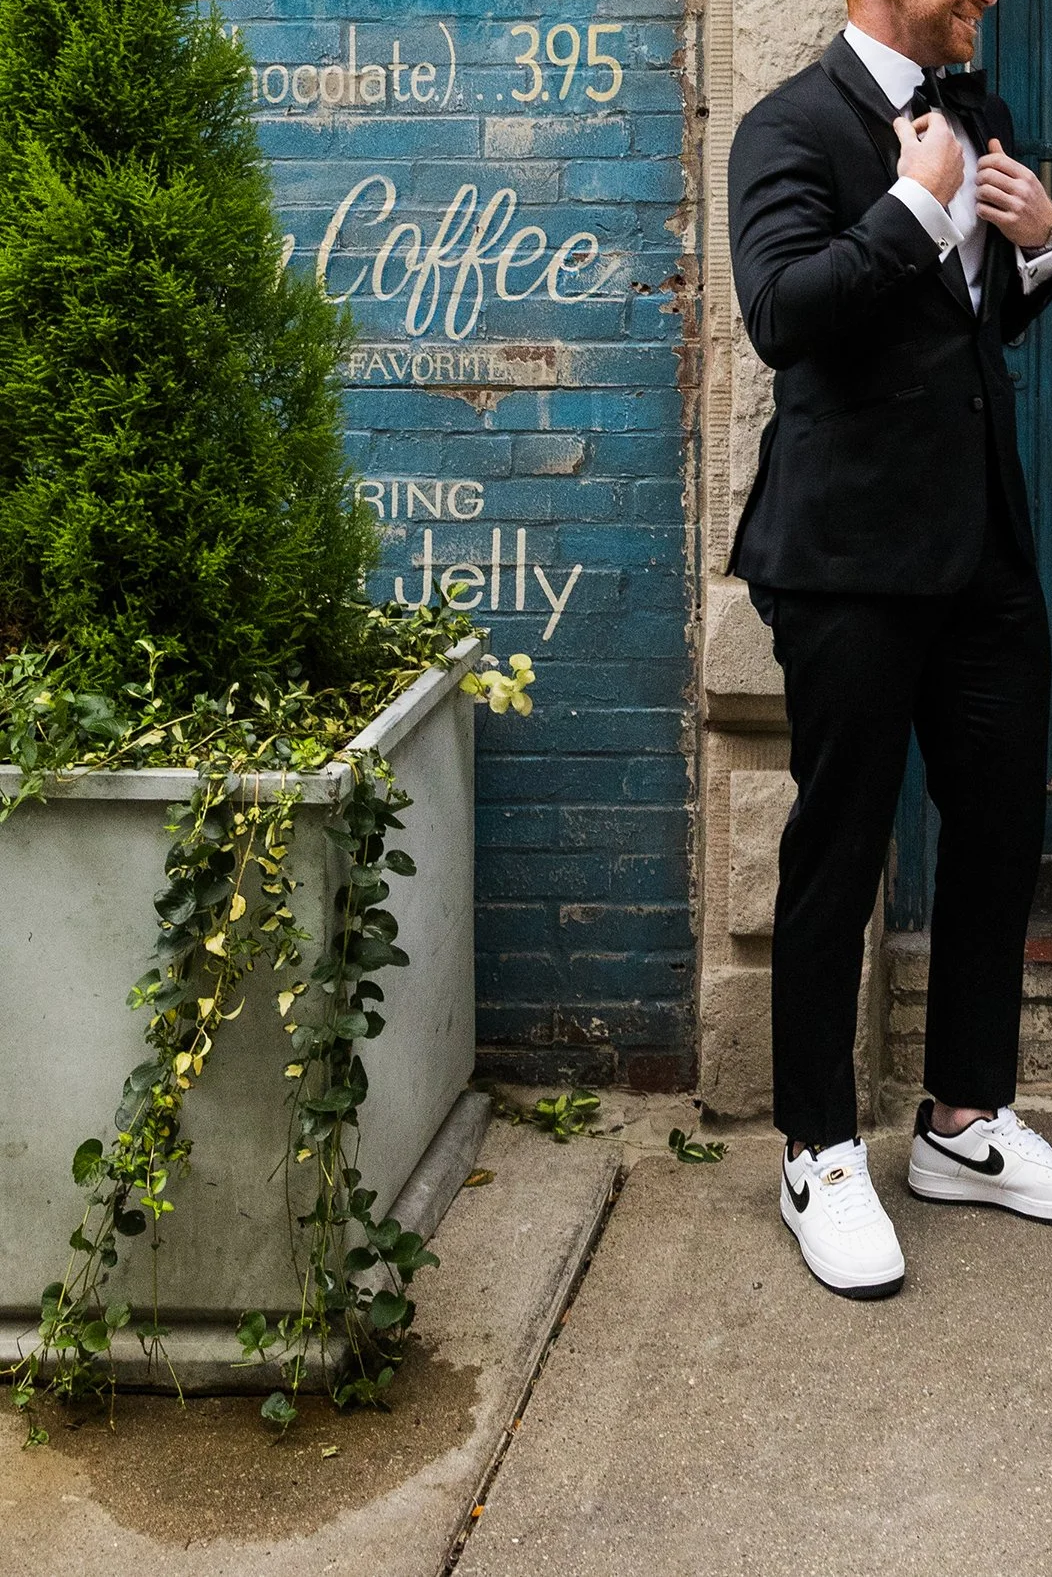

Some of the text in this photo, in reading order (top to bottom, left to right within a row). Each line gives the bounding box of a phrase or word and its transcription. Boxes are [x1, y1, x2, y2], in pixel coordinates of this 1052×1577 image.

[510, 23, 623, 103] 3.95
[315, 174, 625, 341] Coffee
[394, 527, 583, 641] Jelly
